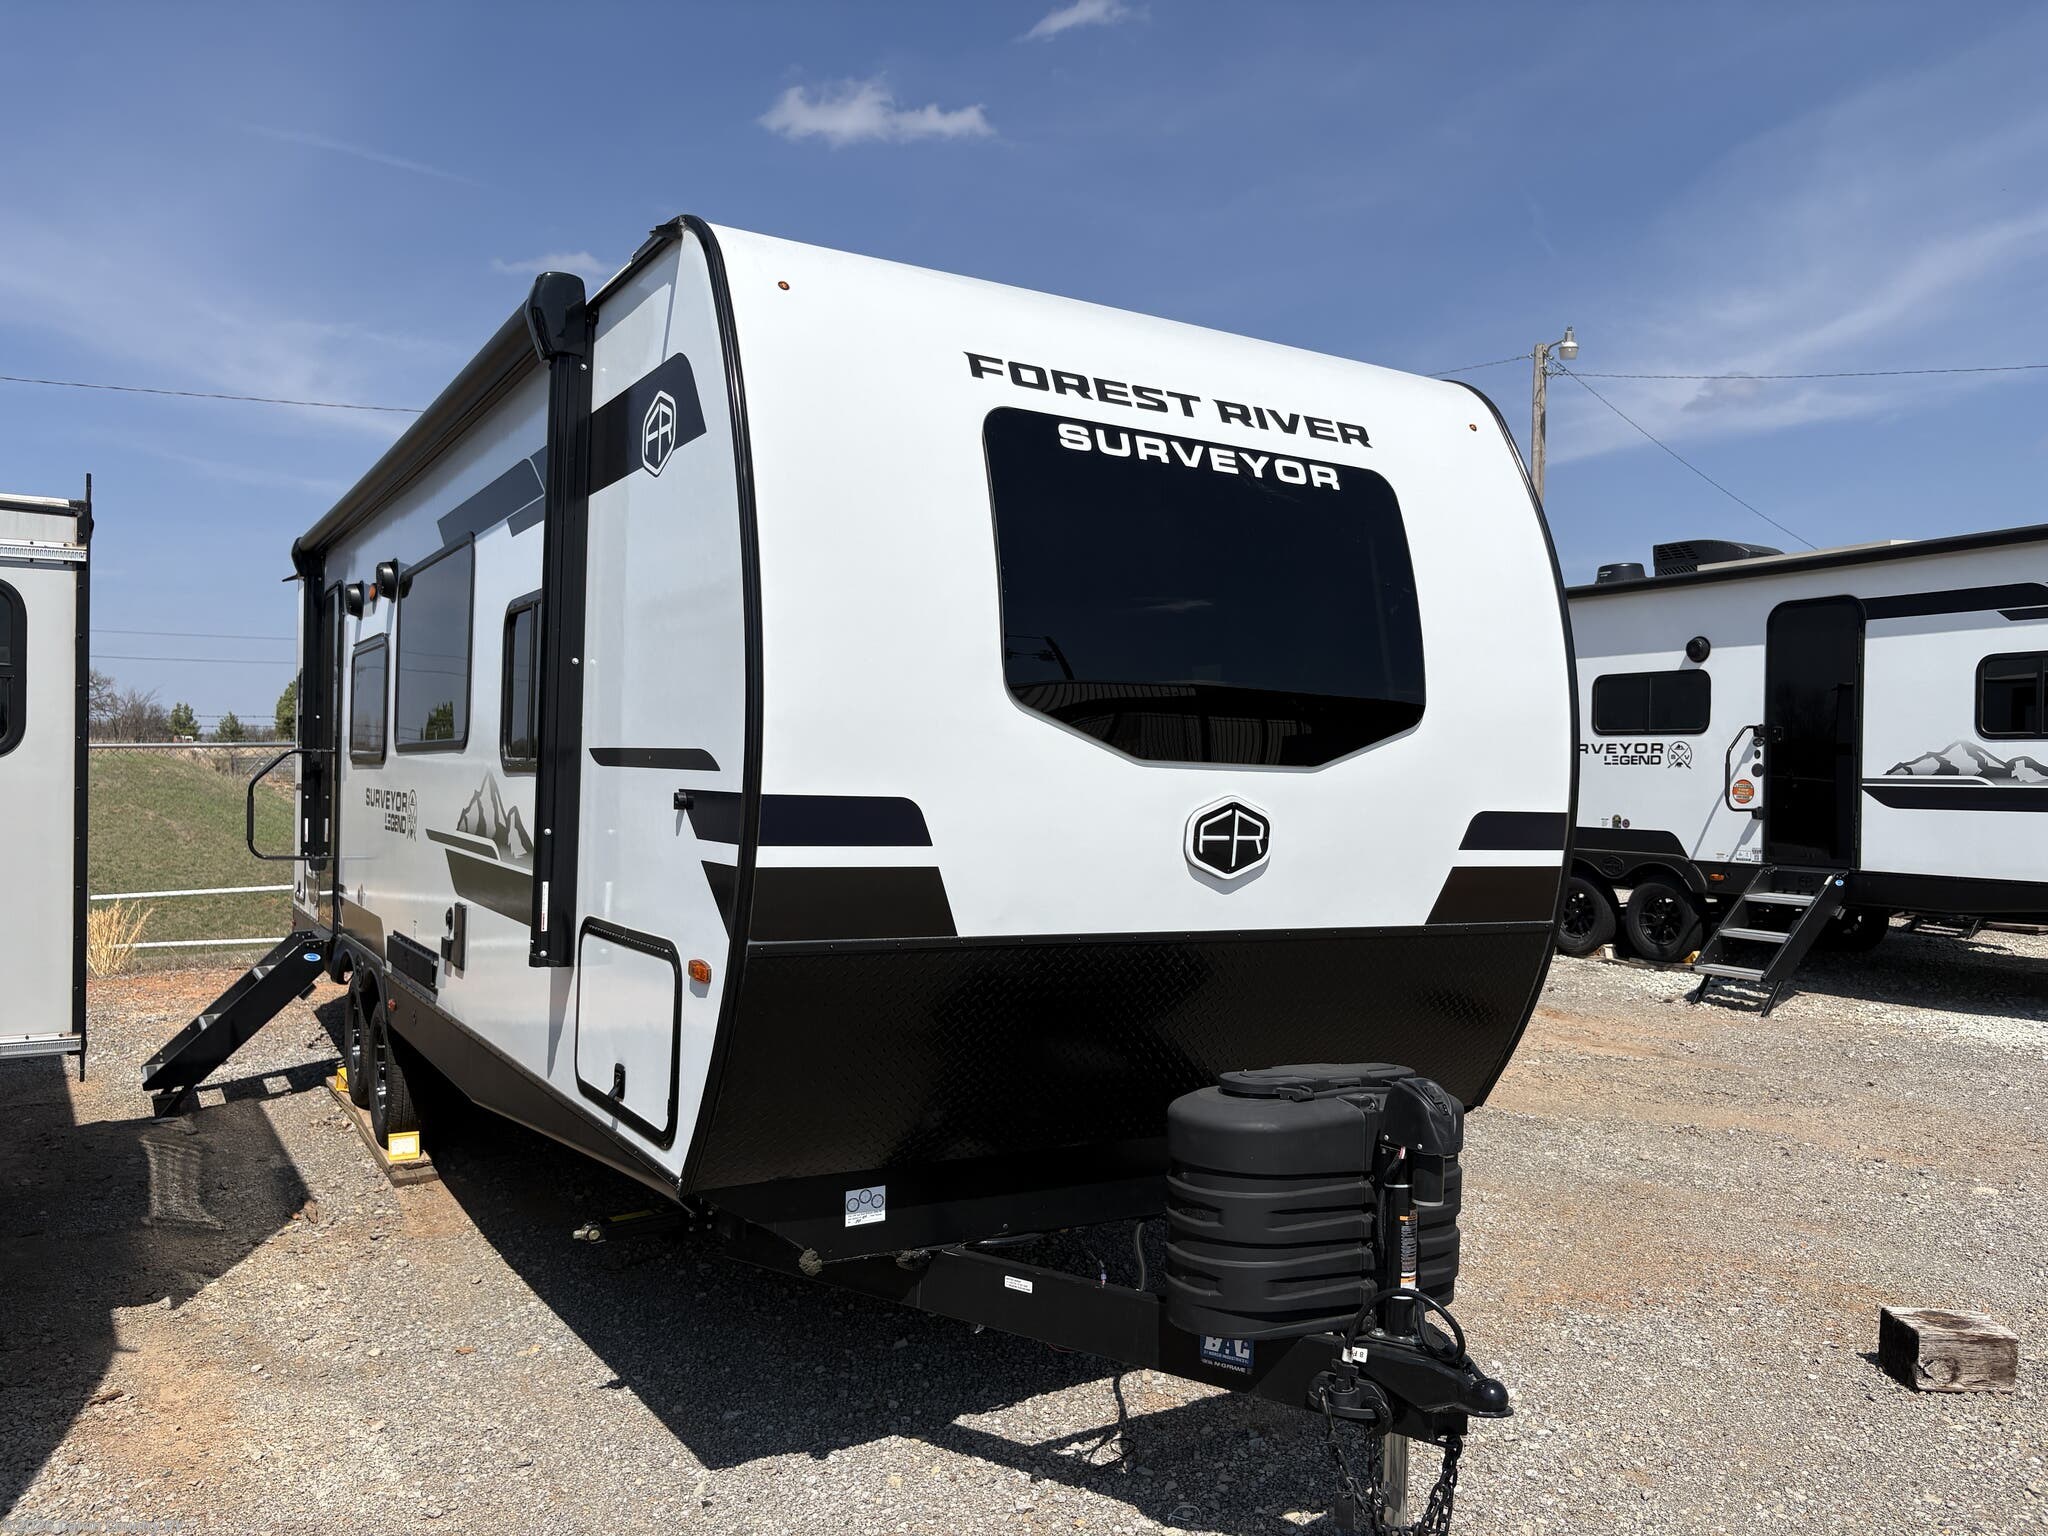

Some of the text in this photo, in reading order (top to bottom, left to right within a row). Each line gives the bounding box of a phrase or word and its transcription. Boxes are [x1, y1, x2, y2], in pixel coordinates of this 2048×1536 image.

[963, 351, 1373, 449] FOREST RIVER
[1057, 423, 1341, 491] SURVEYOR
[1604, 755, 1662, 766] LEGEND
[365, 787, 408, 813] SURVEYOR
[384, 812, 407, 834] LEGEND
